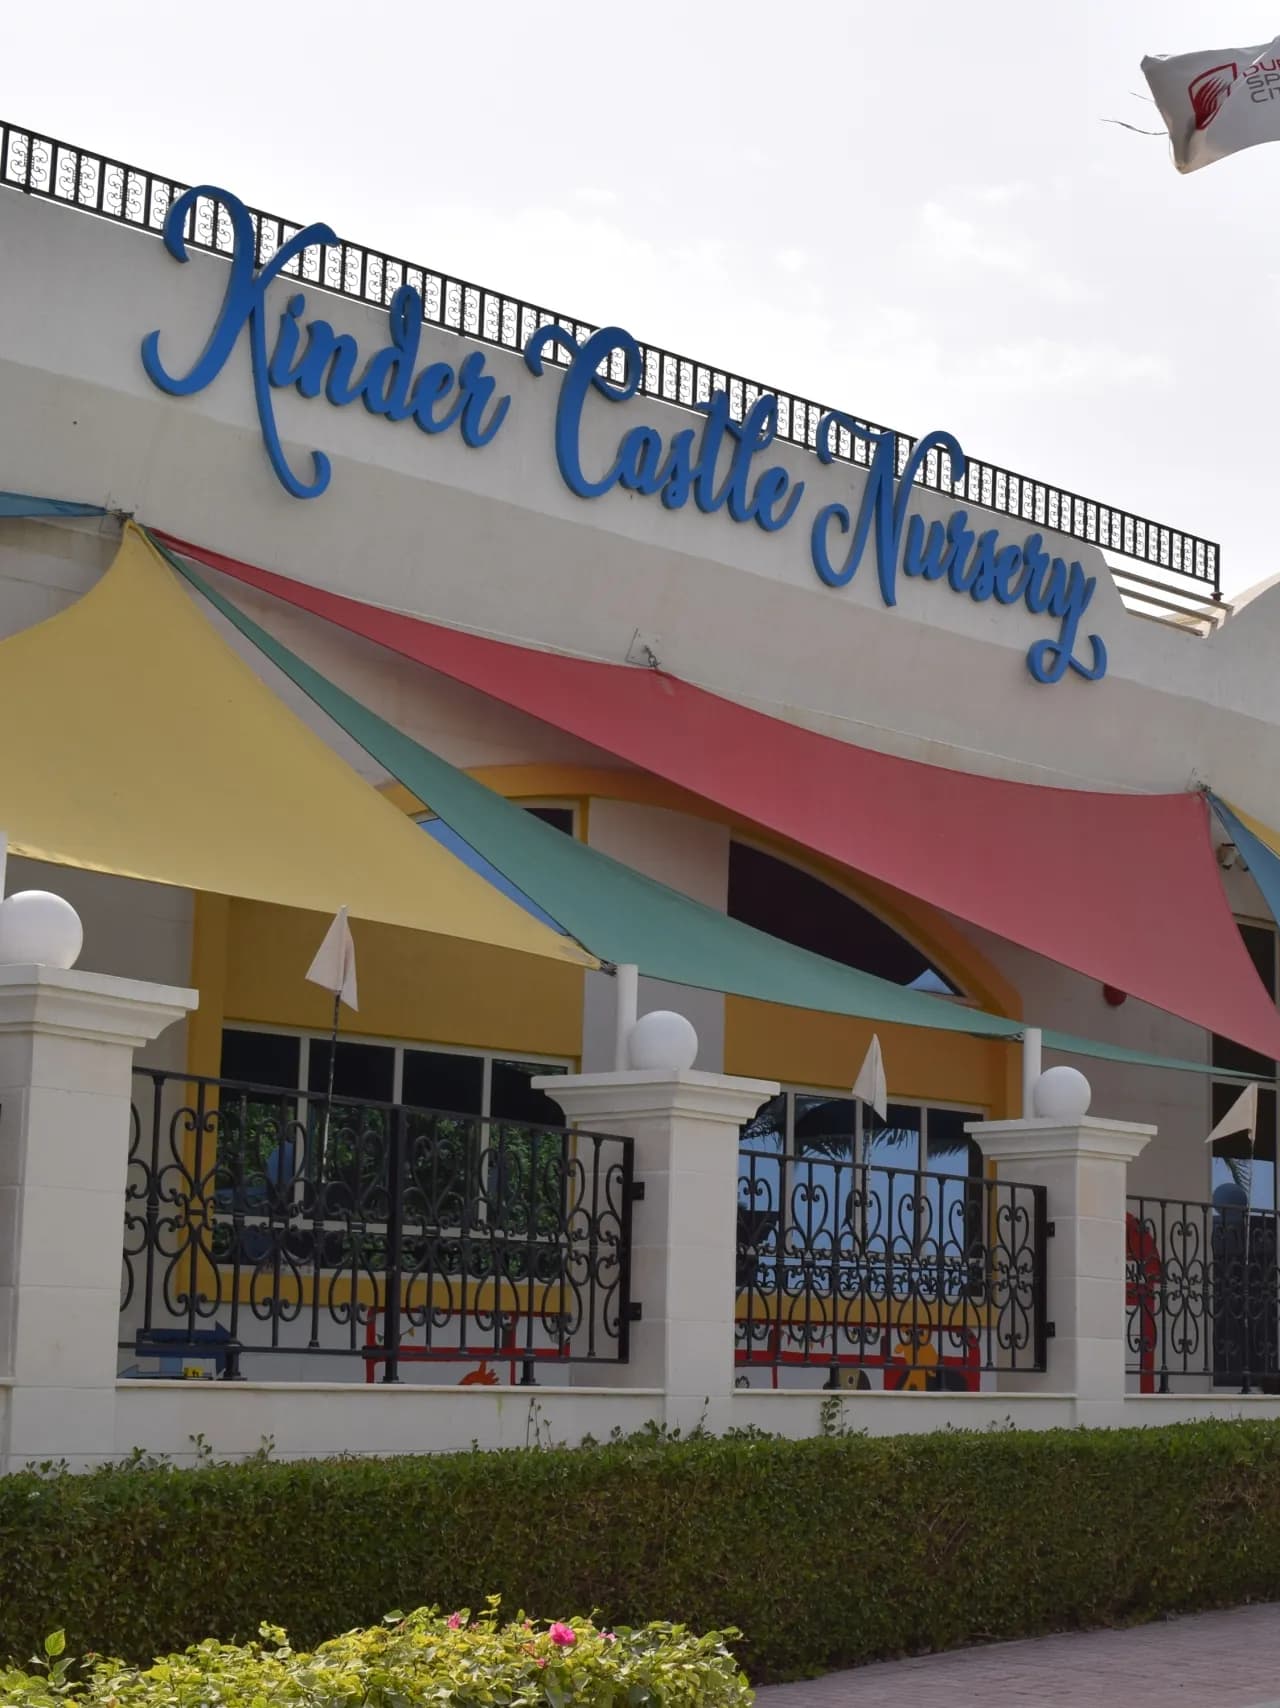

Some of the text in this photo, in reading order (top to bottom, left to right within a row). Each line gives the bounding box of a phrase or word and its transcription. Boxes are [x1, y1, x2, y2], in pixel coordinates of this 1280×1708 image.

[141, 184, 1108, 684] Kinder Castle Nursery
